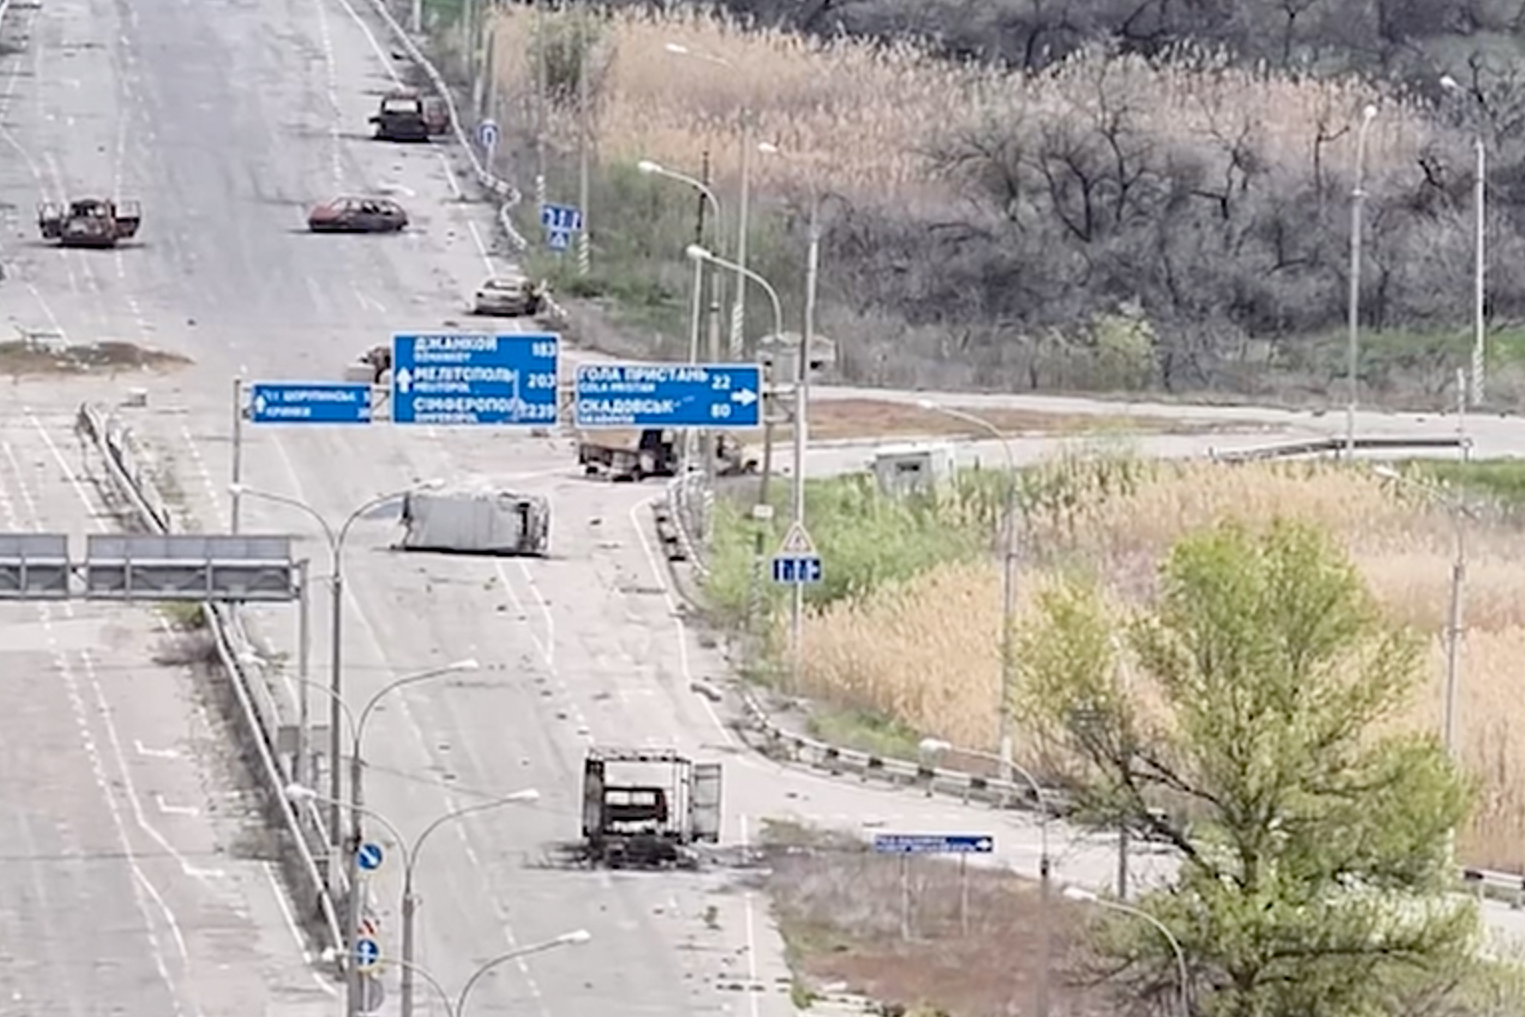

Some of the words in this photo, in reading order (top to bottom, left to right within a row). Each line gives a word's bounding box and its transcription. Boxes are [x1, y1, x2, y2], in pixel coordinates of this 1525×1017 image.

[413, 337, 498, 352] ДЖАНКОЙ
[413, 367, 514, 383] МЕЛІТОПОЛЬ
[527, 373, 556, 388] 203
[579, 367, 622, 382] ГОЛА
[624, 367, 709, 382] ПРИСТАНЬ
[711, 374, 731, 390] 22
[579, 399, 674, 414] СКАДОВСЬК
